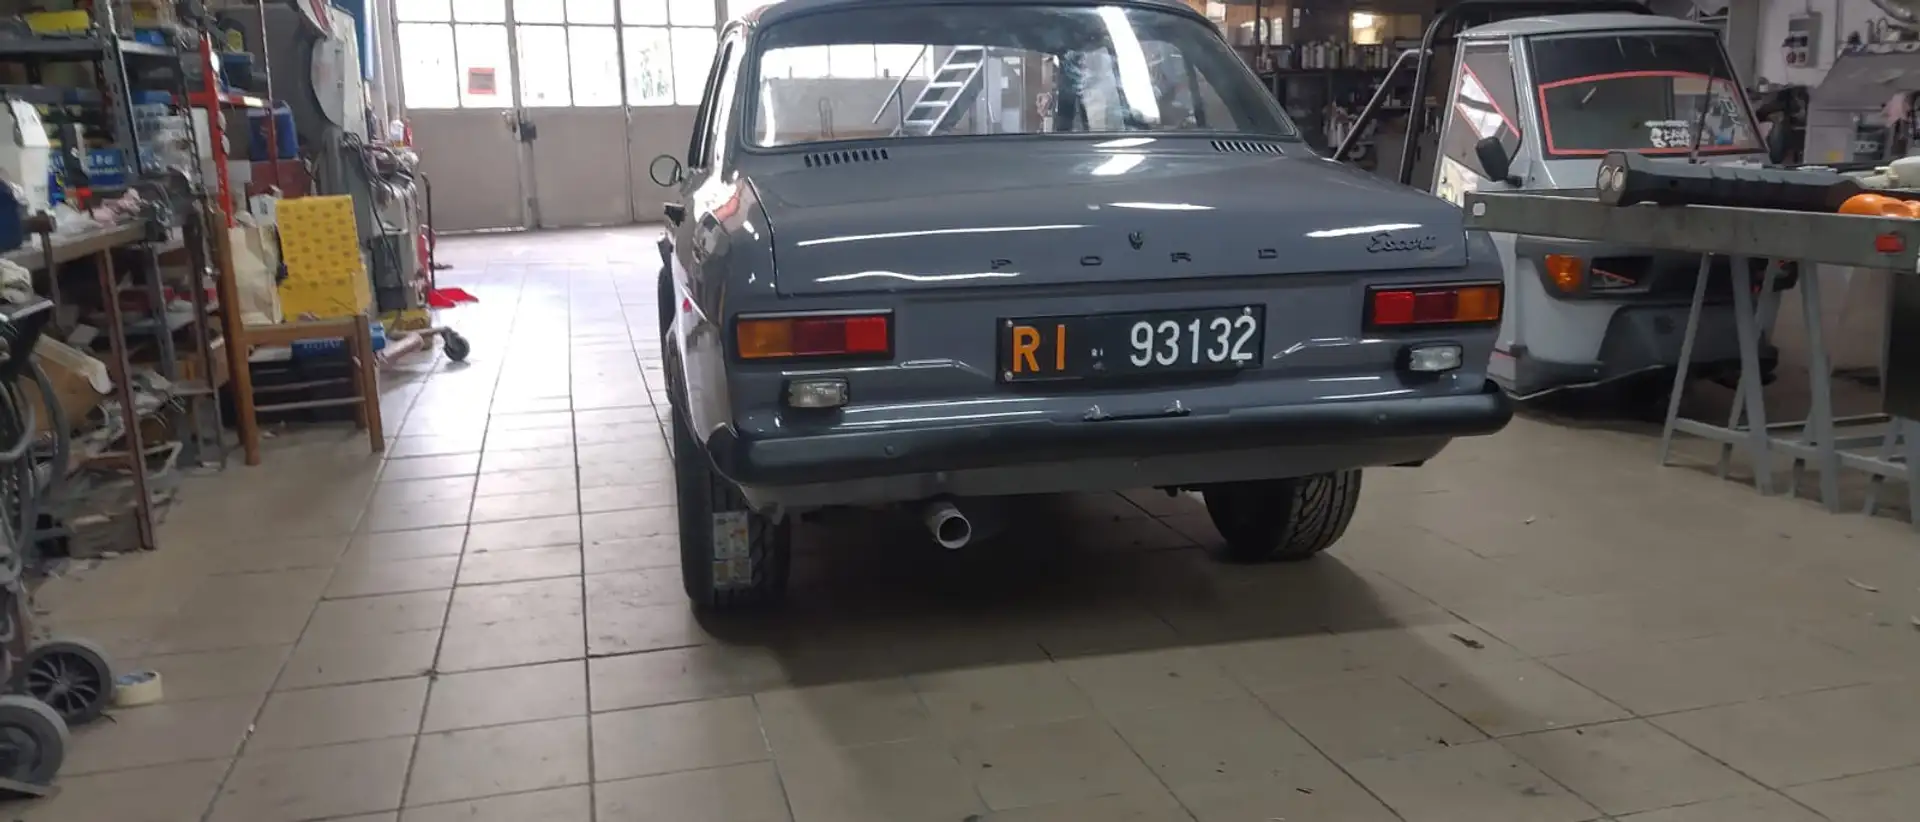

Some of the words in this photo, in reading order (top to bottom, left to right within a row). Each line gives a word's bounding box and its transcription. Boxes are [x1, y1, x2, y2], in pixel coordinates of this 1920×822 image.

[1366, 232, 1437, 253] Escort
[991, 248, 1279, 269] FORD
[1012, 323, 1067, 373] RI
[1129, 315, 1257, 367] 93132
